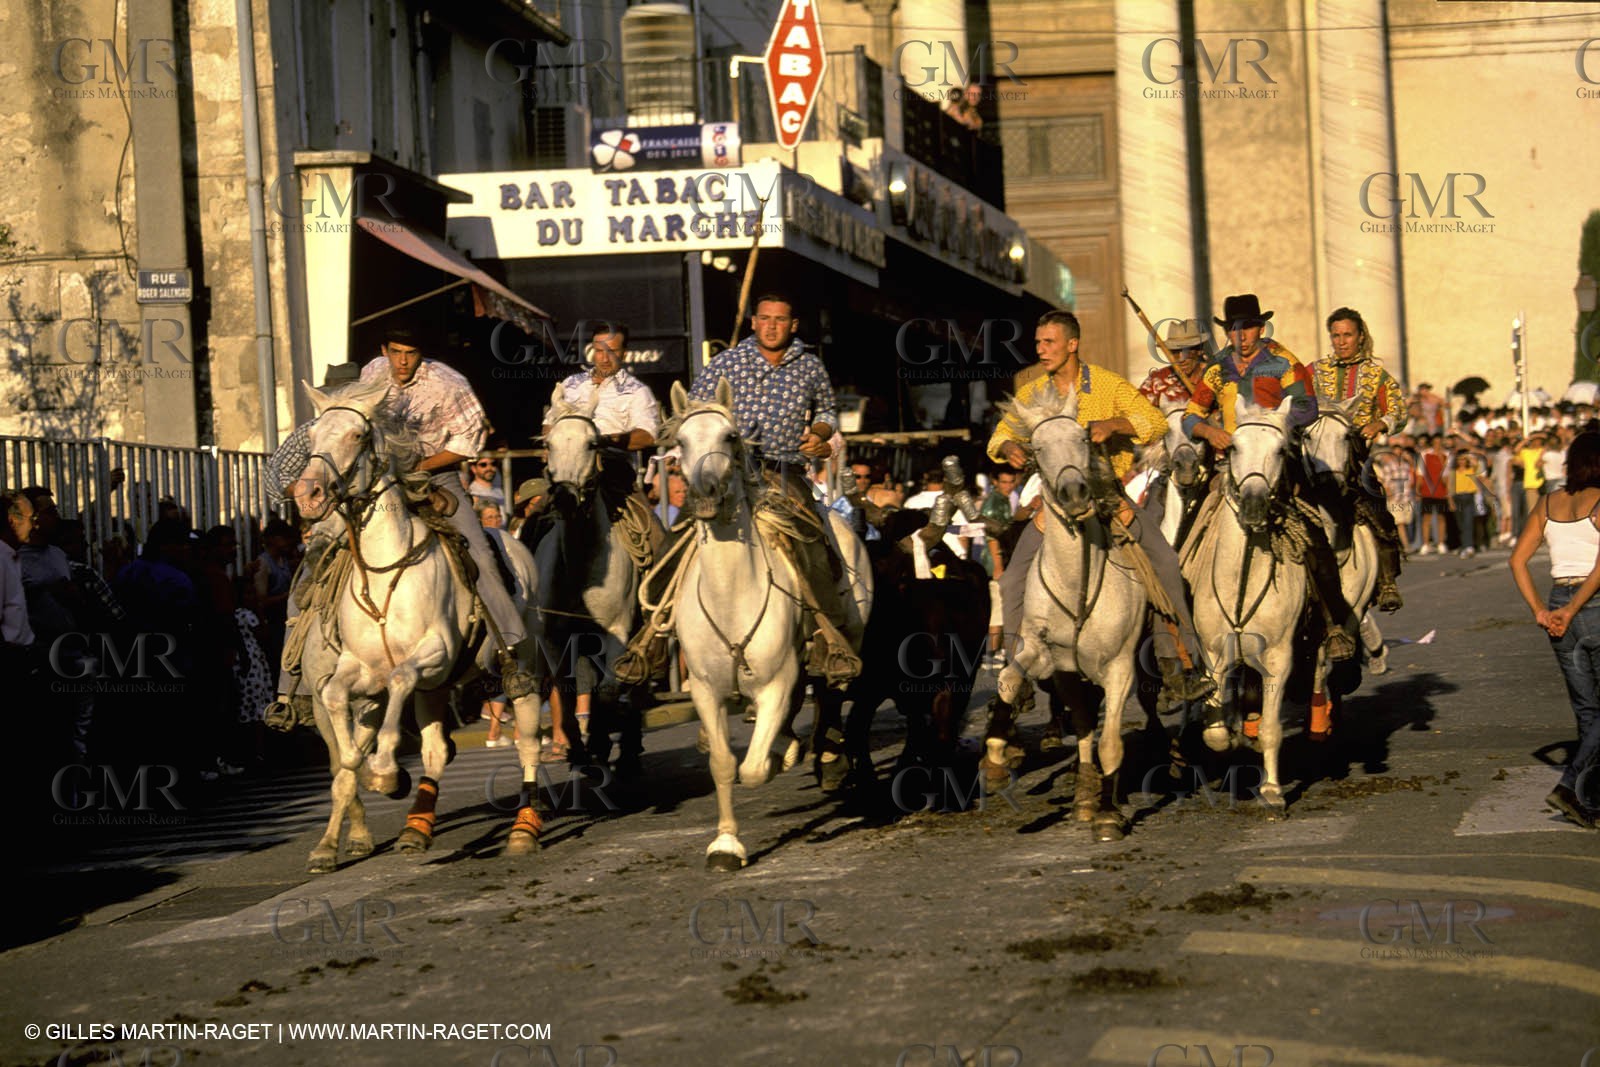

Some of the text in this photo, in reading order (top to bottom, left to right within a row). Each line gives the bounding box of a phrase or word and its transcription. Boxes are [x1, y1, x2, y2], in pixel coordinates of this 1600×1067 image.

[778, 0, 813, 134] TABAC
[646, 149, 698, 159] DES JEUX
[499, 174, 726, 210] BAR TABAC
[535, 217, 584, 247] DU
[151, 273, 177, 285] RUE
